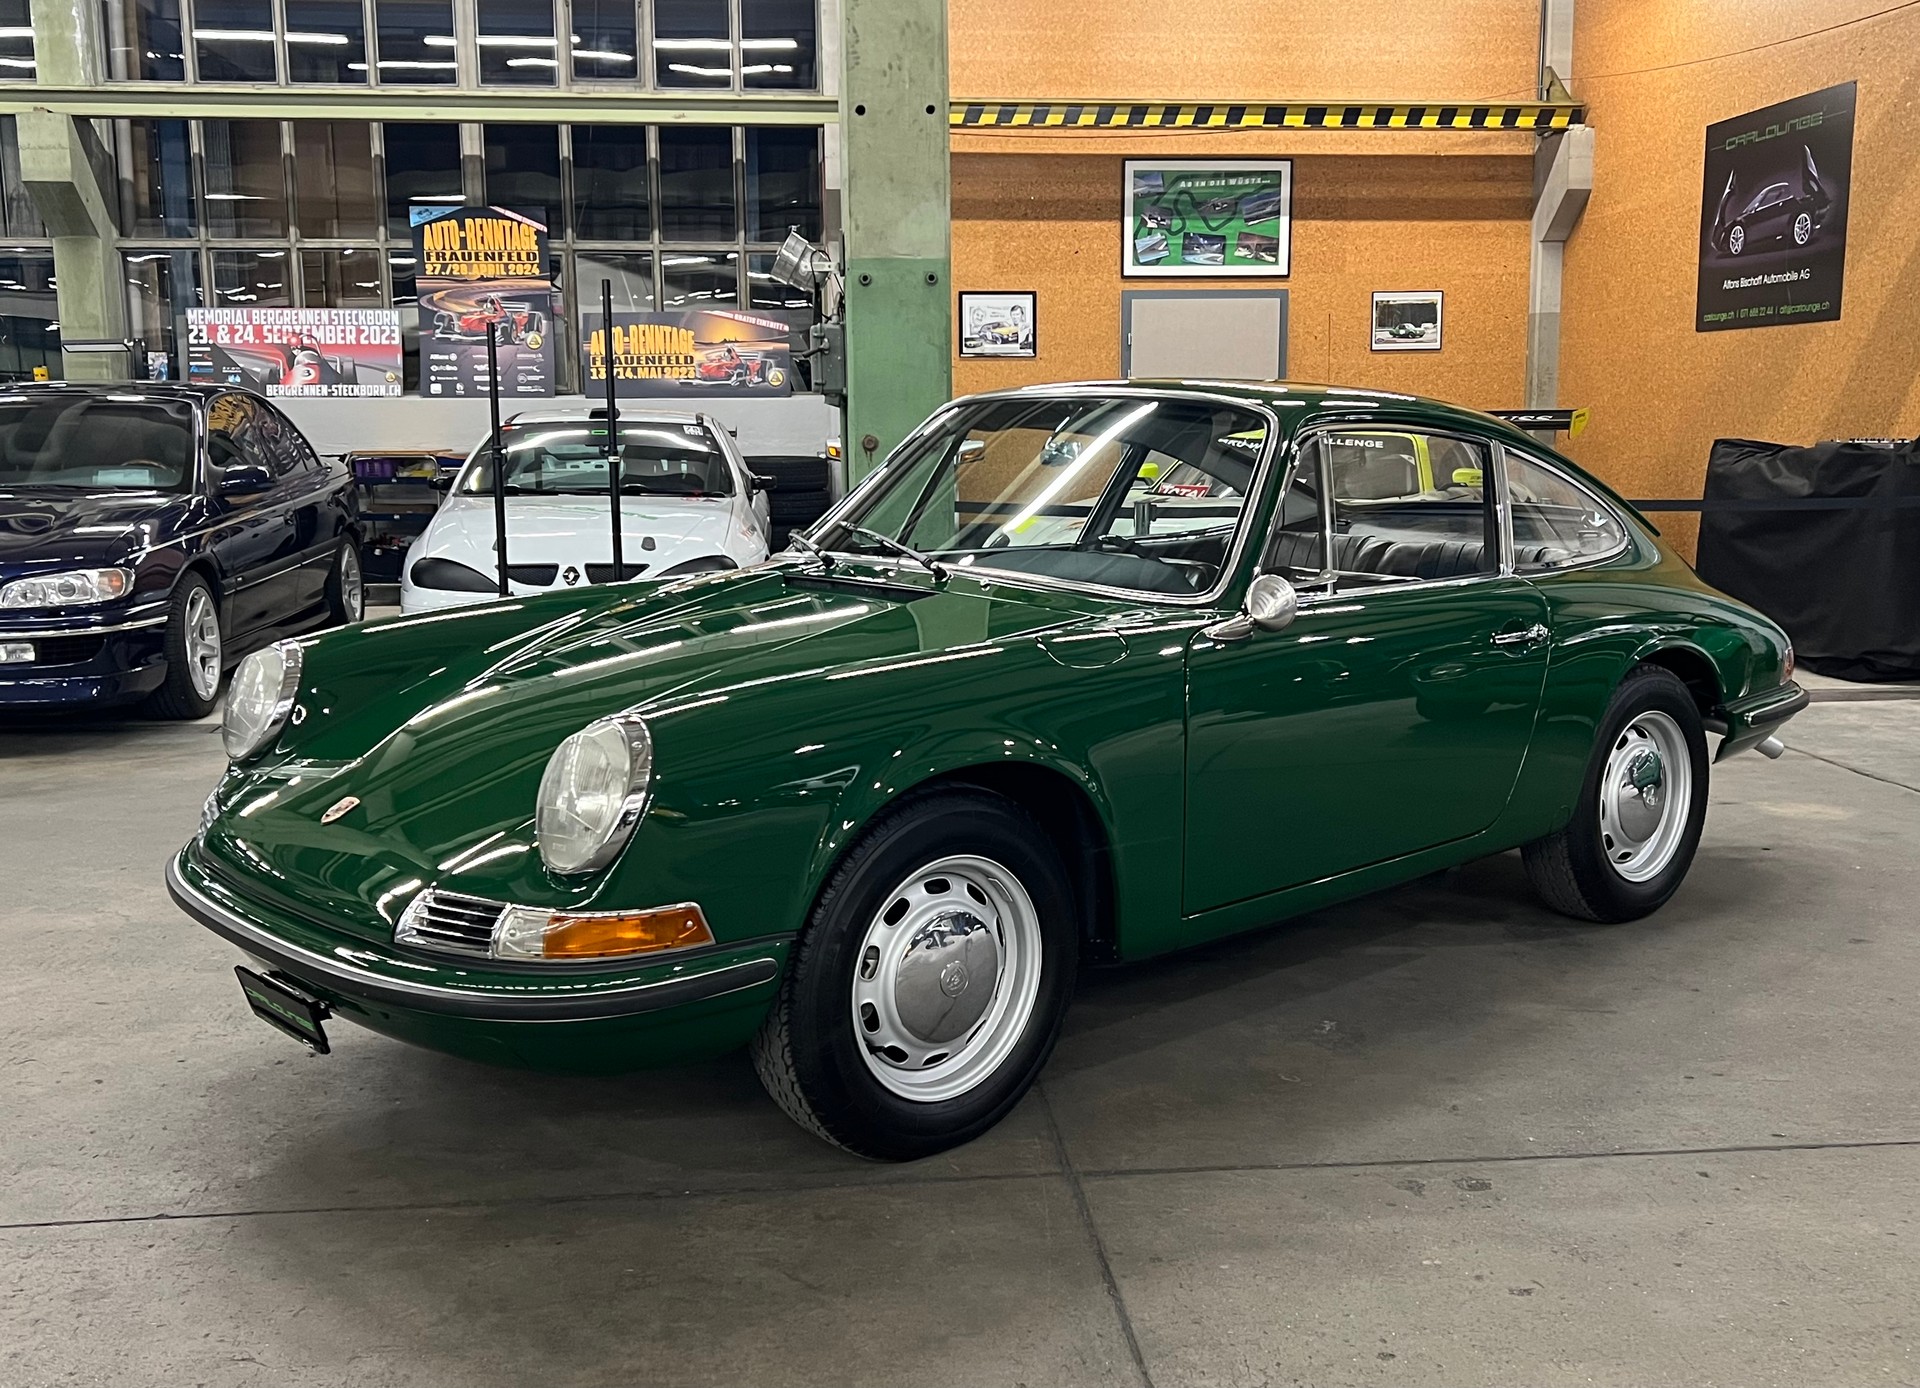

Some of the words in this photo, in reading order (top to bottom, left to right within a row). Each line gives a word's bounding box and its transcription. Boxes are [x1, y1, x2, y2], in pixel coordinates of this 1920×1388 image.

[1725, 112, 1823, 150] CARLOUNGE
[424, 218, 539, 251] AUTO-RENNTAGE
[425, 251, 538, 262] FRAUENFELD
[1763, 271, 1799, 285] Automobile
[1799, 268, 1811, 280] AG
[187, 309, 250, 325] MEMORIAL
[252, 309, 329, 325] BERGRENNEN
[331, 310, 399, 326] STECKBORN
[188, 325, 213, 344] 23.
[217, 325, 231, 344] &
[234, 325, 260, 344] 24.
[360, 325, 400, 345] 2023
[266, 384, 401, 397] BERGRENNEN-STECKBORN.CH
